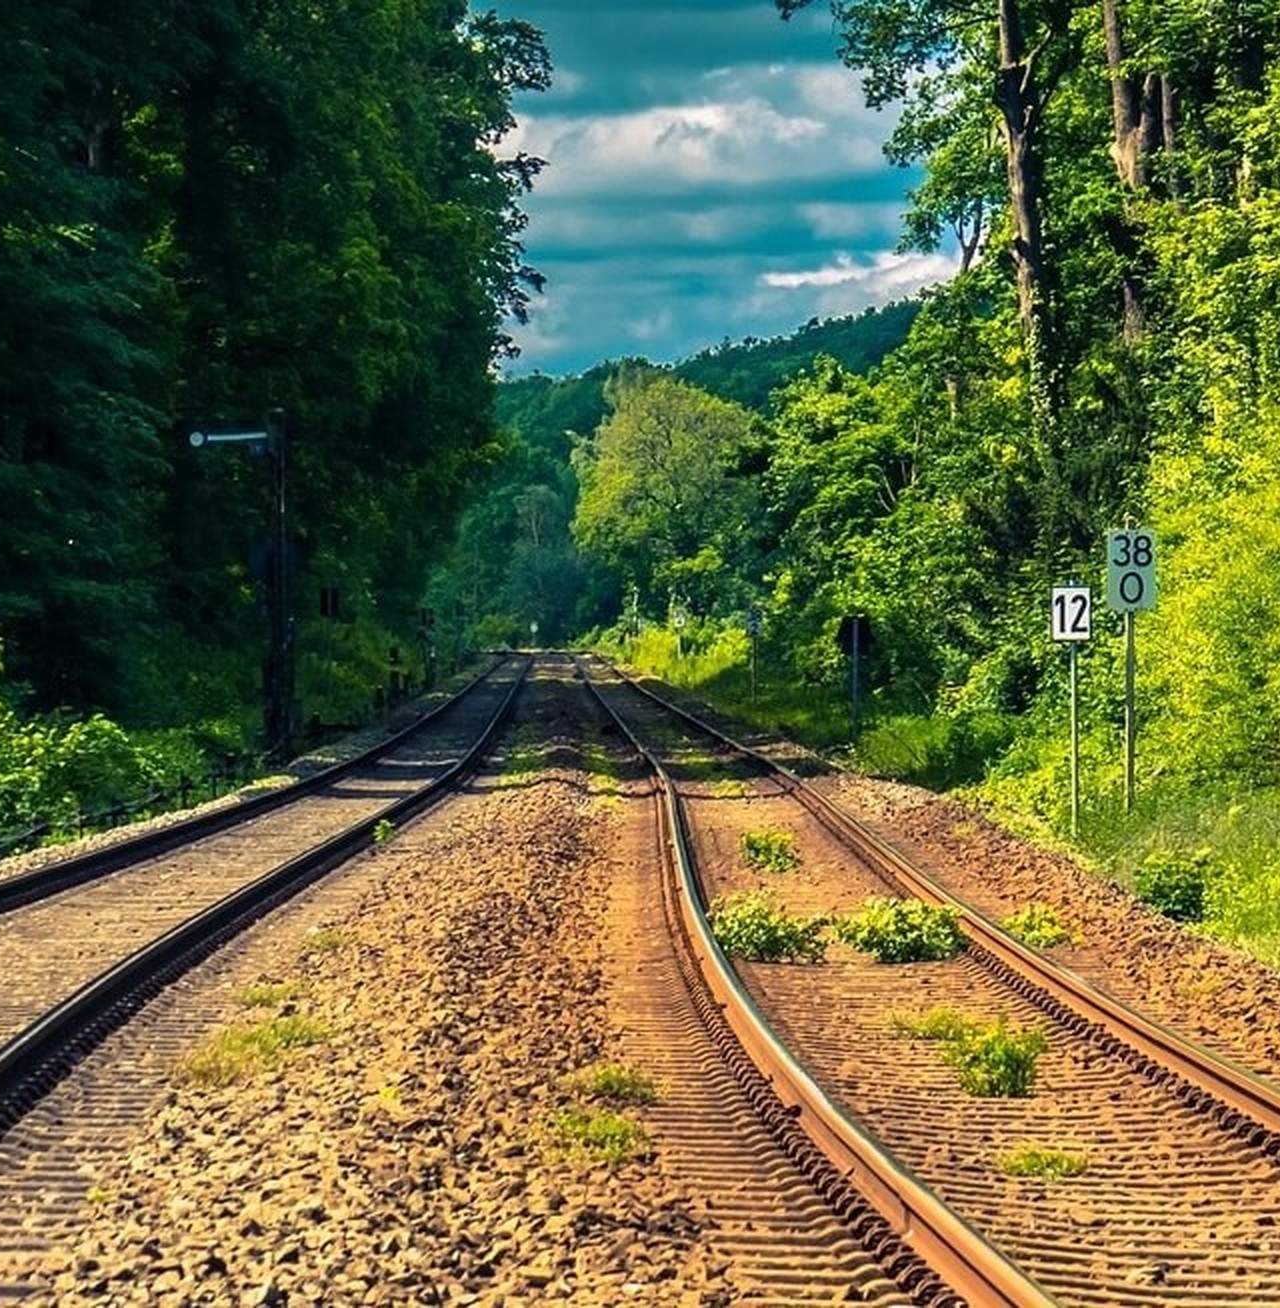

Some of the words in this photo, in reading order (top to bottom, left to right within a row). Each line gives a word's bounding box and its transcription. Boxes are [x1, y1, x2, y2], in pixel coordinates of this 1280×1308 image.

[1113, 535, 1152, 567] 38
[1120, 572, 1144, 604] 0
[1055, 594, 1088, 633] 12
